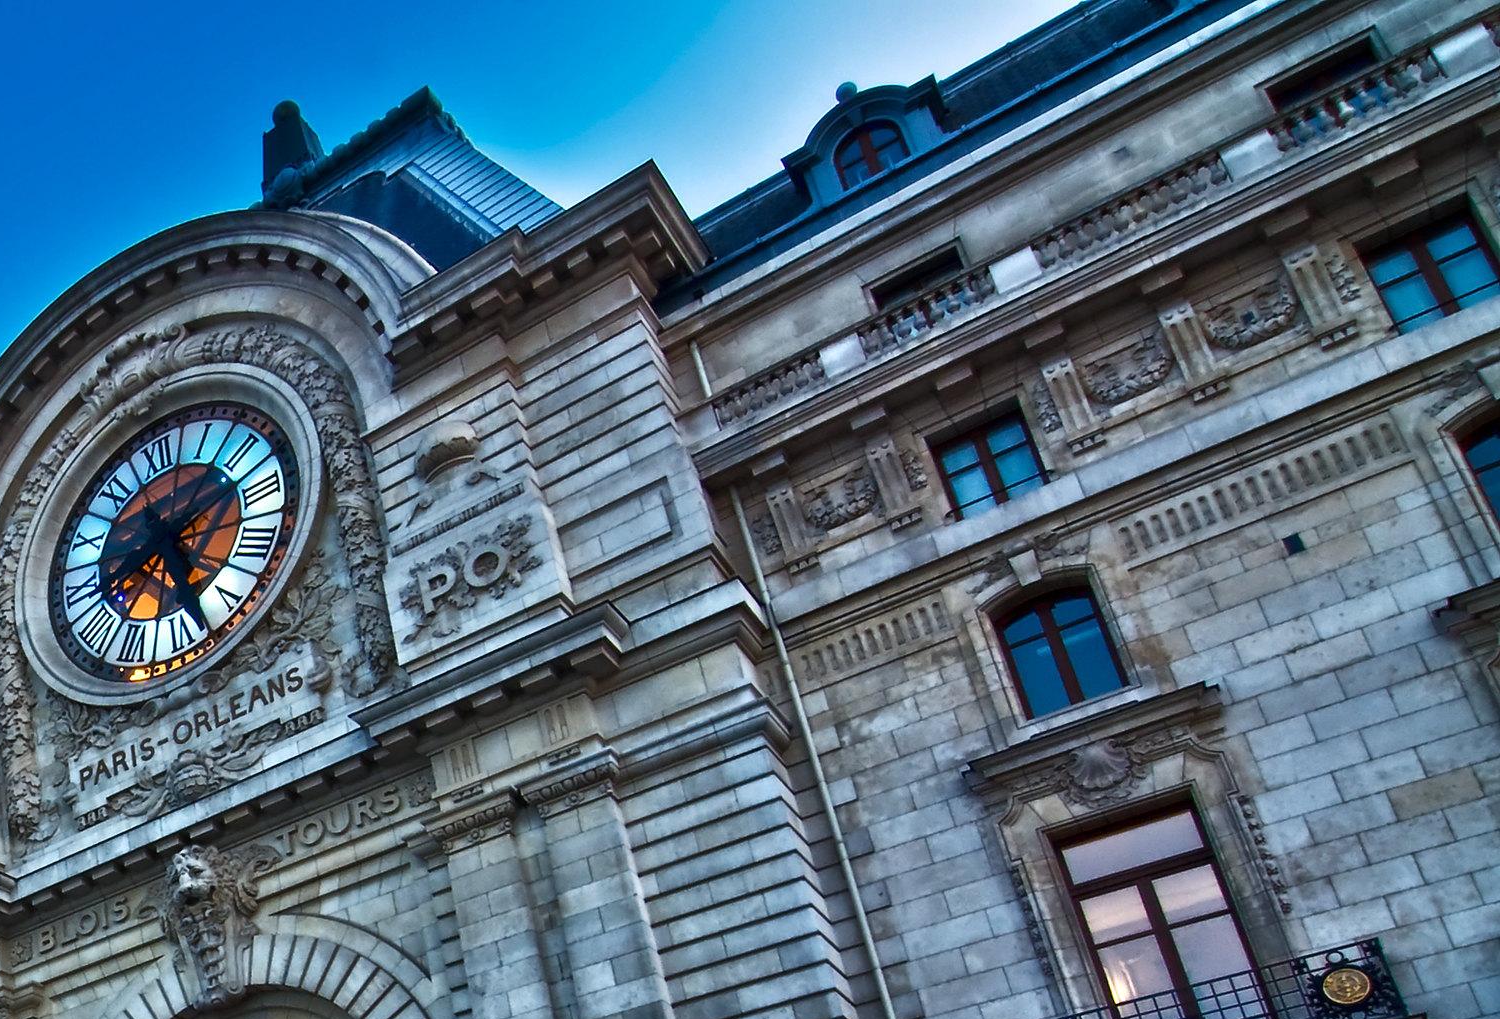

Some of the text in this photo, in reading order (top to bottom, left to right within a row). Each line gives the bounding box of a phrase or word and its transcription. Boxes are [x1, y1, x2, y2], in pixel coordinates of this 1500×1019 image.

[140, 434, 173, 480] XII
[193, 422, 212, 459] I
[223, 432, 259, 472] II
[98, 474, 133, 513] XI
[242, 469, 280, 510] III
[72, 531, 105, 552] X
[233, 525, 277, 560] IIII
[65, 570, 100, 609] IX
[215, 585, 243, 613] V
[417, 545, 508, 615] PO
[77, 604, 116, 654] VIII
[116, 623, 146, 662] VII
[168, 614, 196, 653] VI
[78, 667, 304, 791] PARIS-ORLEANS
[276, 784, 400, 856] TOURS
[37, 896, 130, 954] BLOIS
